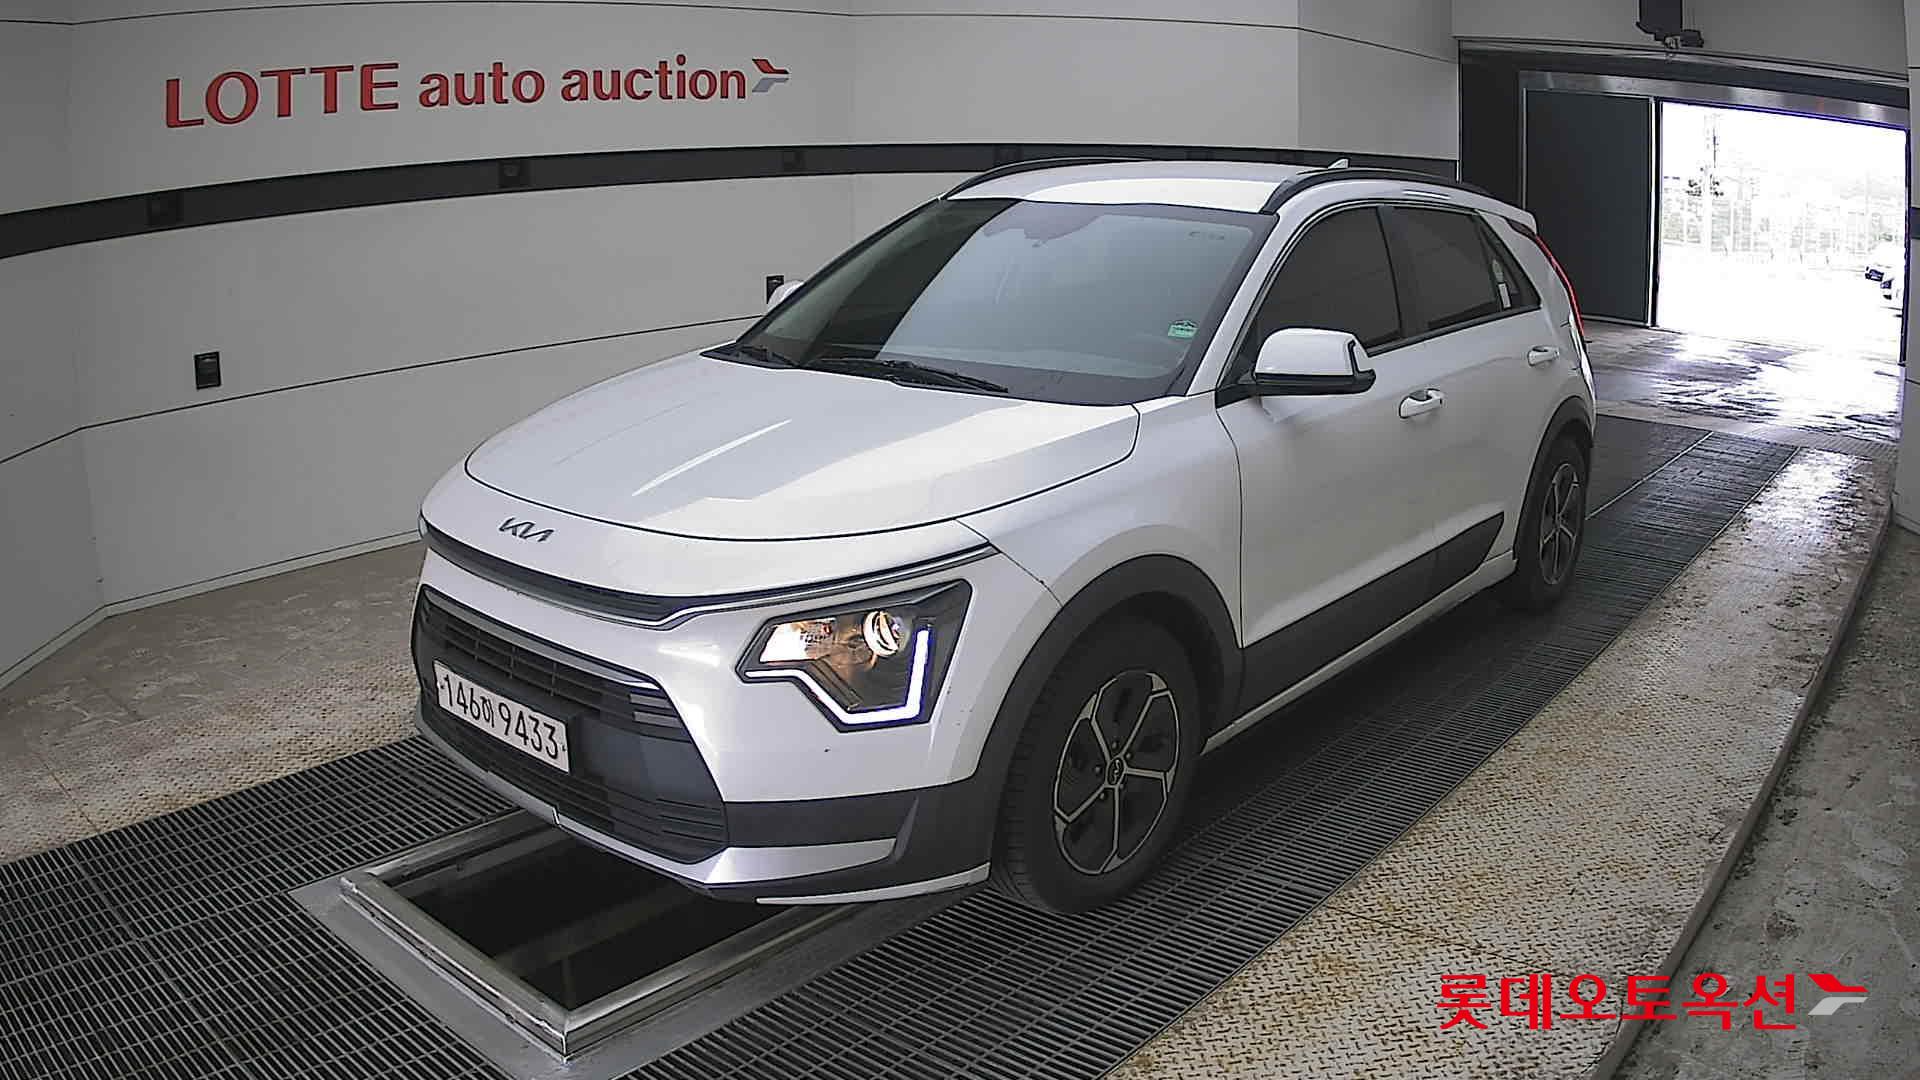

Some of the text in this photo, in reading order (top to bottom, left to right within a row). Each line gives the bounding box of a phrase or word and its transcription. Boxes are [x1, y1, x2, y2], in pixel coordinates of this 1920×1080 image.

[165, 54, 746, 128] LOTTE auto auction
[499, 517, 554, 542] KIA
[498, 702, 559, 760] 9433
